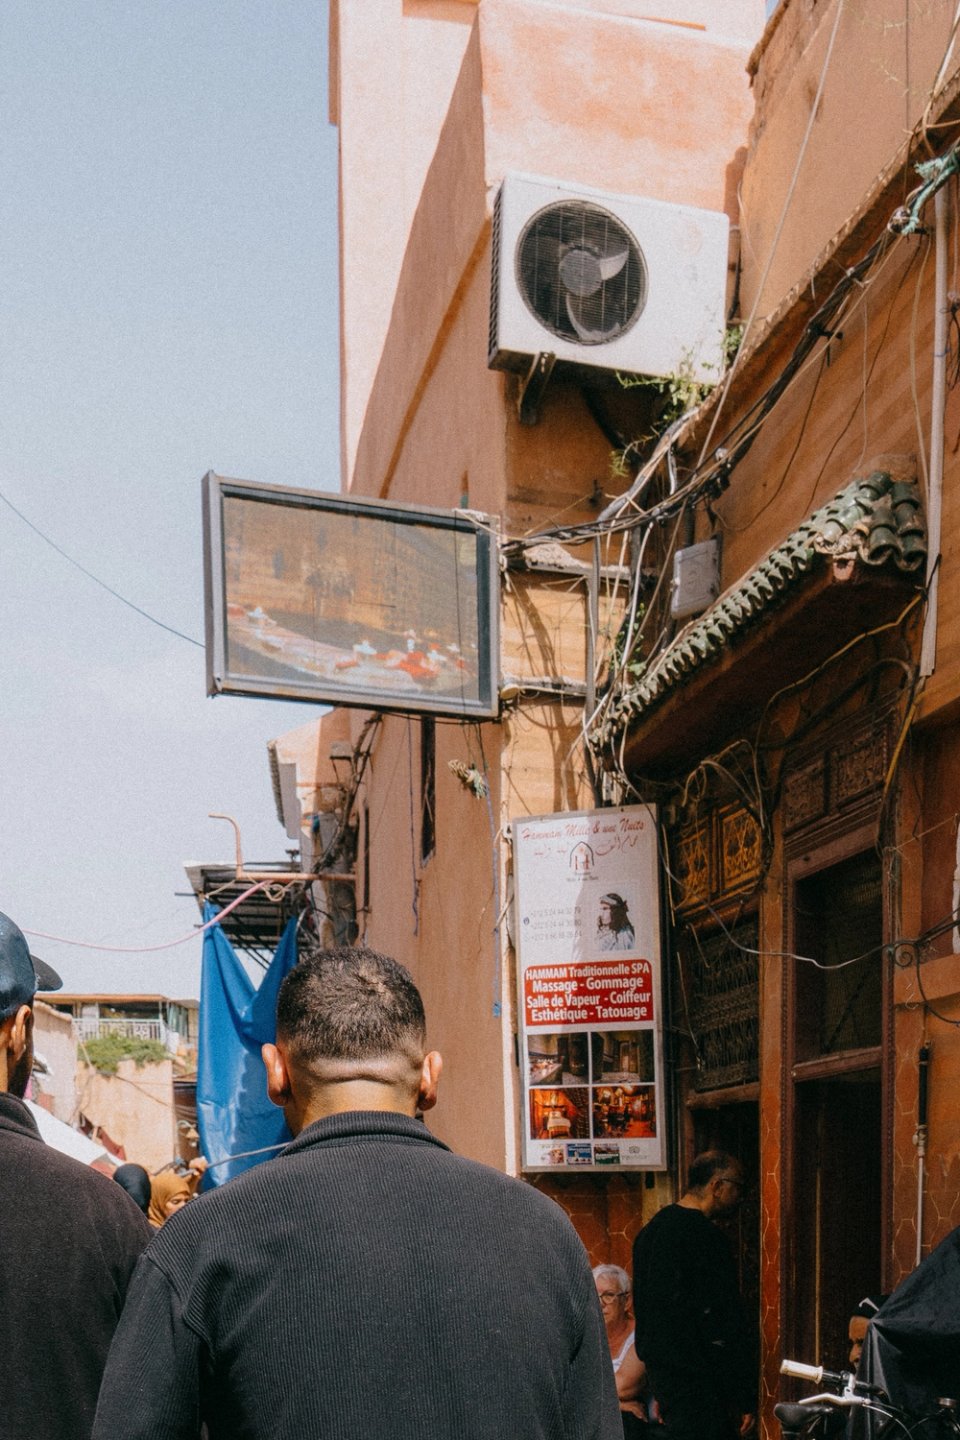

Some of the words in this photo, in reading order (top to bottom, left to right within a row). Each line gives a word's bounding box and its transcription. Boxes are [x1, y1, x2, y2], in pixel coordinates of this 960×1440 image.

[526, 967, 567, 980] HAMMAM
[568, 963, 630, 978] Traditionnelle
[631, 962, 650, 975] SPA
[532, 980, 578, 994] Massage
[586, 976, 644, 991] Gommage
[526, 994, 550, 1008] Salle
[551, 993, 564, 1007] de
[565, 993, 600, 1009] Vapeur
[610, 990, 651, 1004] Coiffeur
[532, 1007, 588, 1023] Esthétique
[595, 1005, 647, 1020] Tatouage
